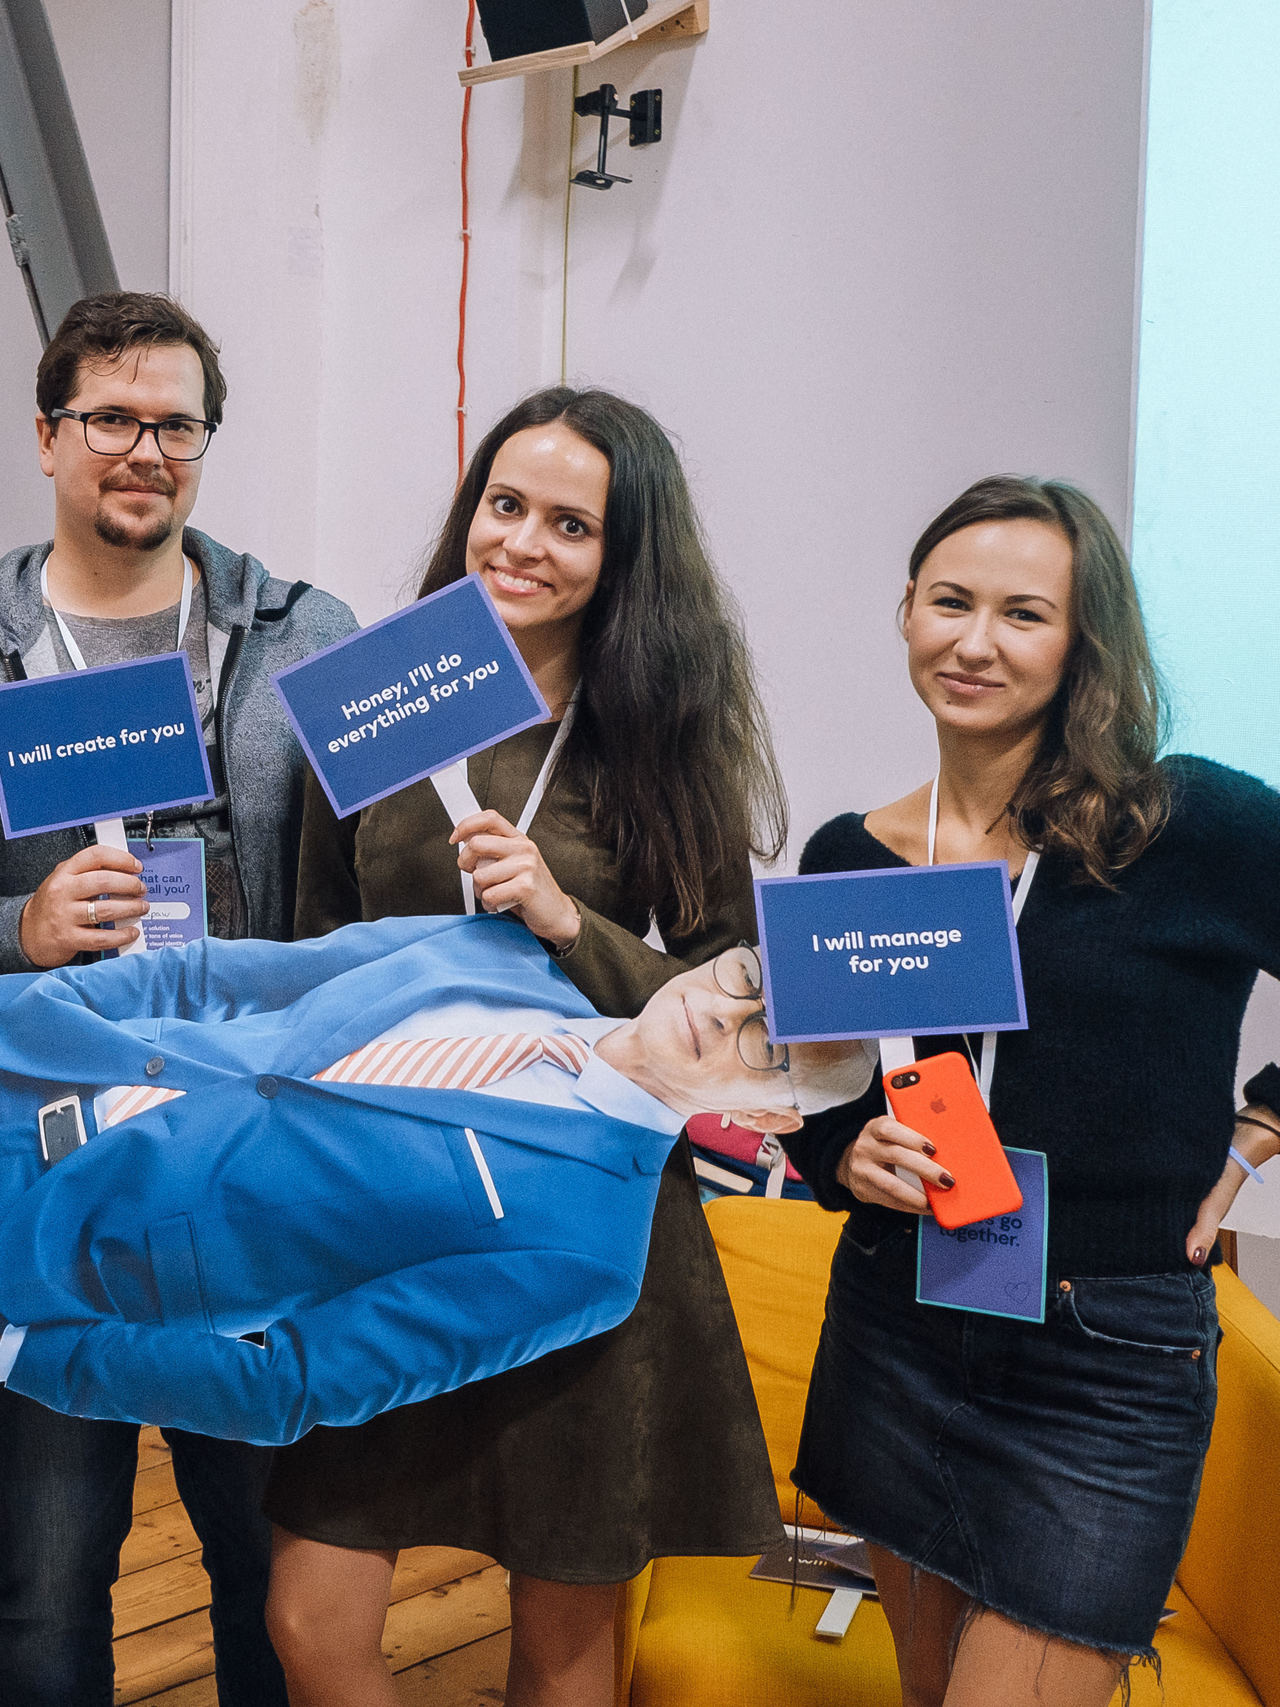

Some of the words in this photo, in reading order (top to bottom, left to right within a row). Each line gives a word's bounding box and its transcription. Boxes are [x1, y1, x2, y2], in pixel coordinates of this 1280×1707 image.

[341, 681, 409, 721] Honey,
[407, 662, 435, 687] I'll
[436, 653, 462, 674] do
[327, 695, 430, 754] everything
[429, 684, 459, 703] for
[461, 660, 500, 691] you
[8, 751, 15, 767] I
[18, 743, 52, 765] will
[56, 735, 117, 758] create
[119, 728, 148, 746] for
[151, 722, 185, 744] you
[139, 874, 159, 884] hat
[161, 875, 183, 884] can
[146, 884, 161, 894] all
[164, 884, 191, 897] you?
[812, 934, 820, 952] I
[823, 931, 864, 951] will
[869, 929, 962, 948] manage
[848, 955, 883, 974] for
[887, 956, 929, 976] you
[1000, 1215, 1023, 1232] go
[798, 1559, 828, 1567] will
